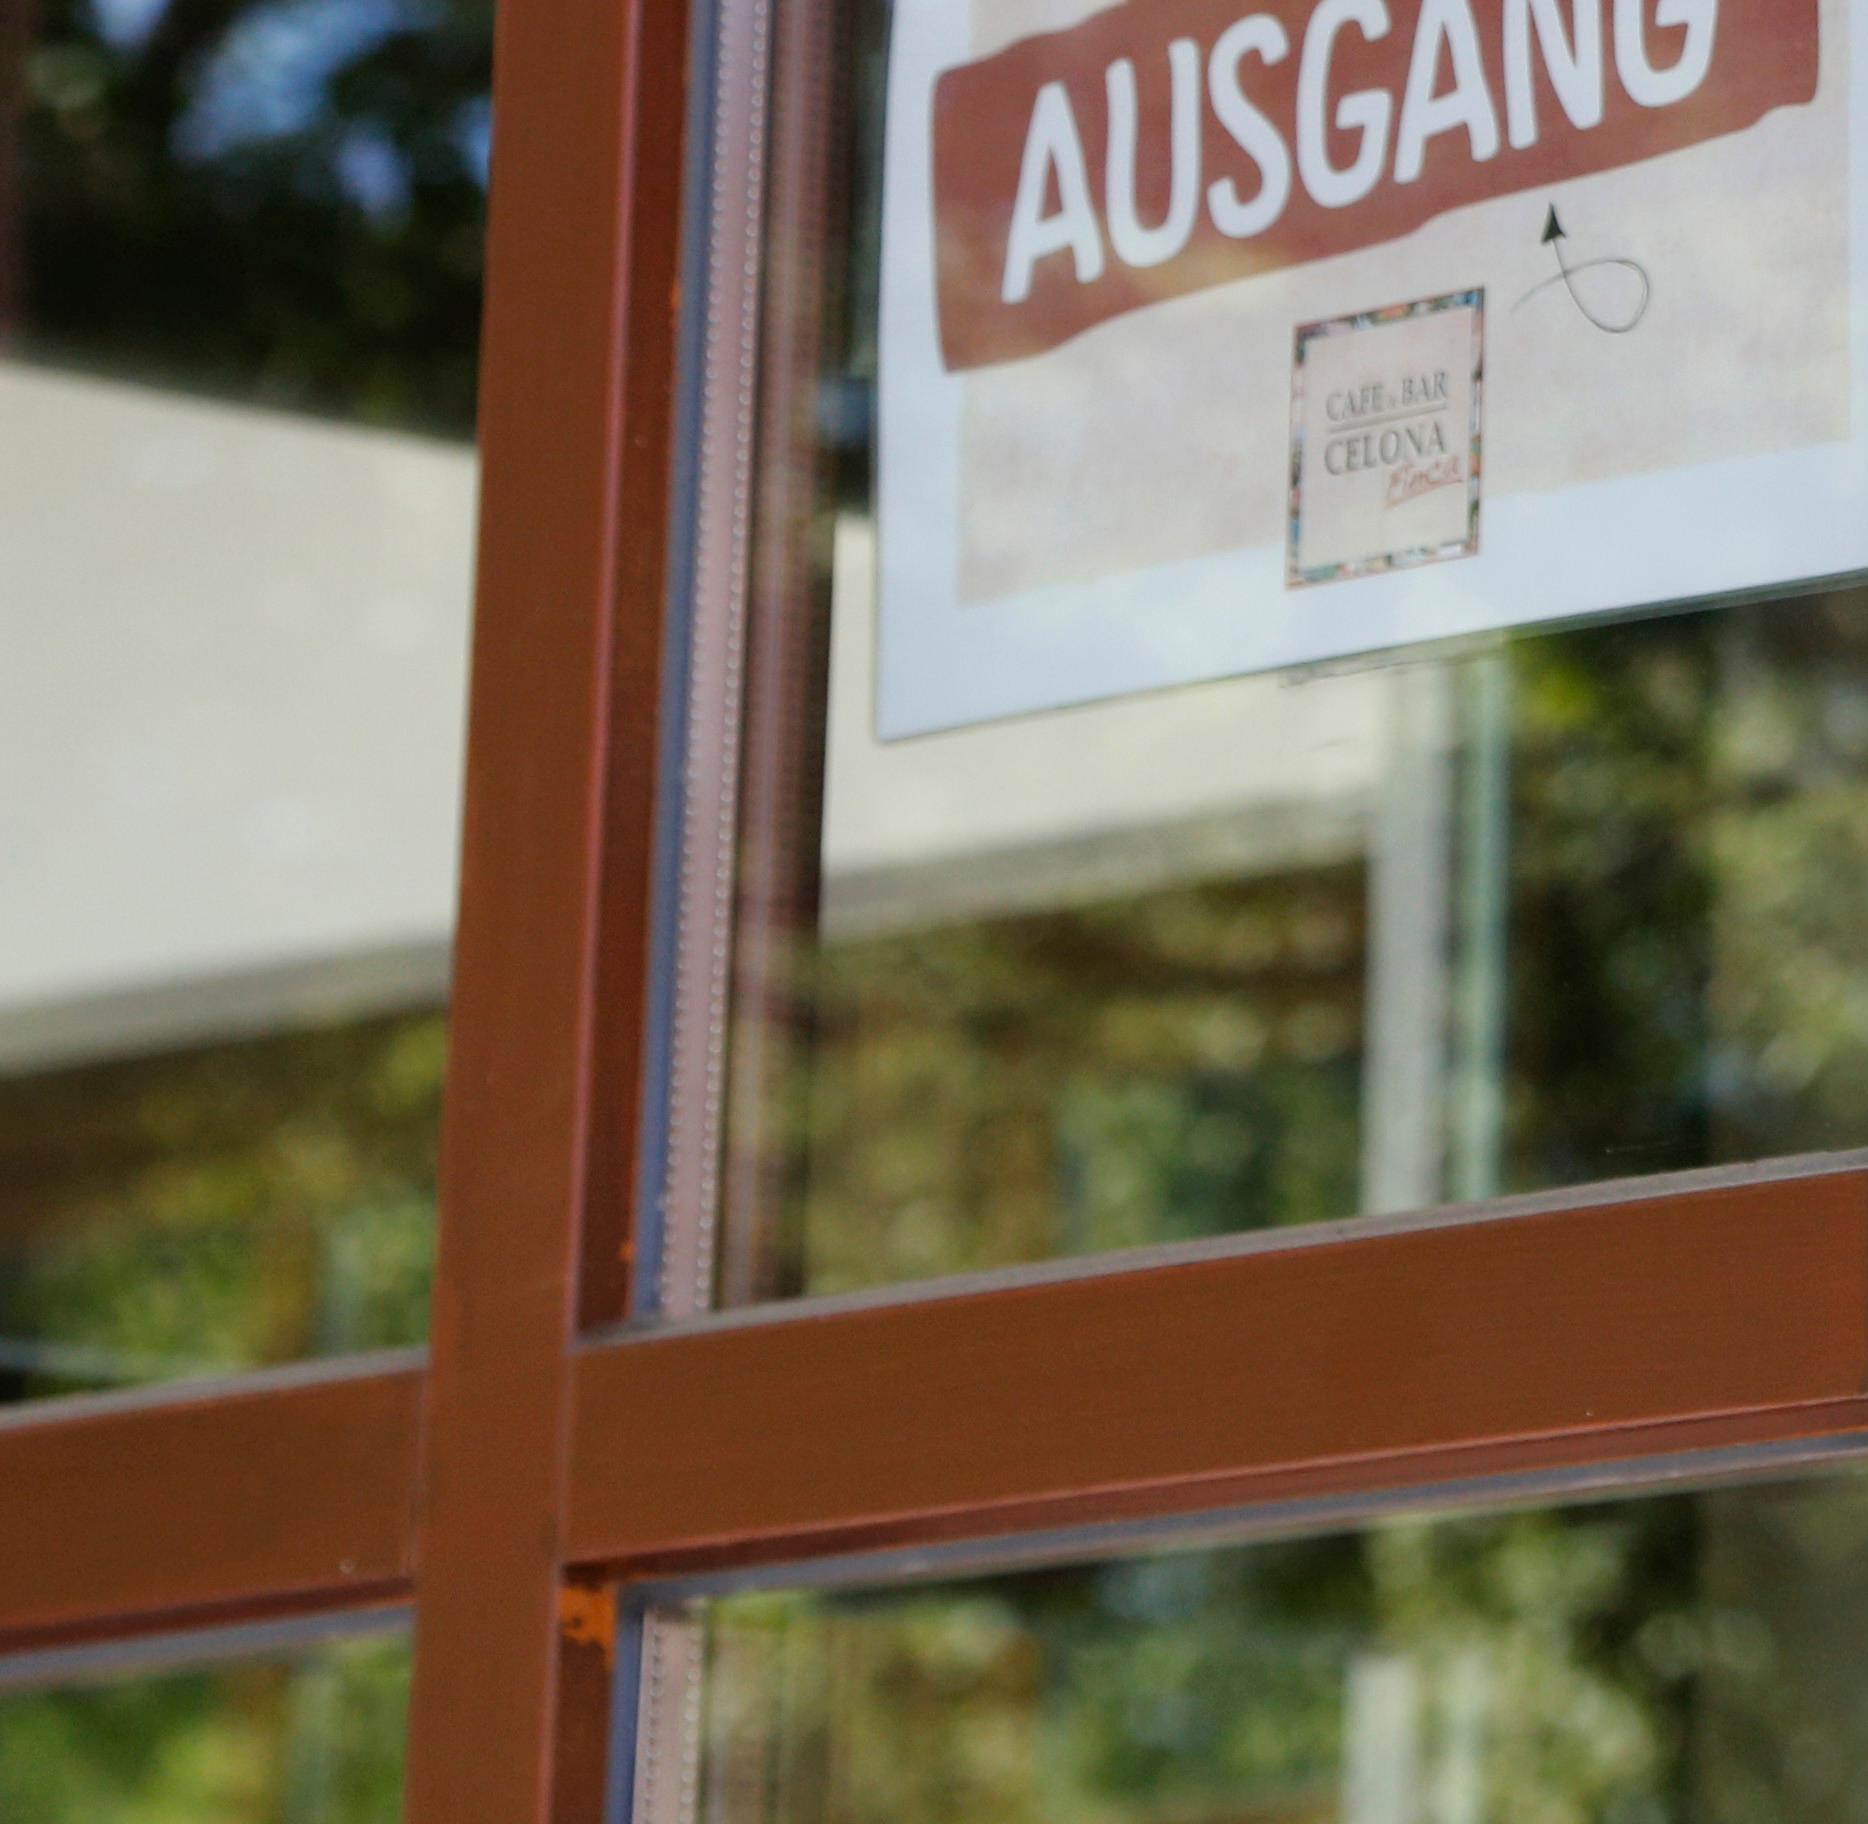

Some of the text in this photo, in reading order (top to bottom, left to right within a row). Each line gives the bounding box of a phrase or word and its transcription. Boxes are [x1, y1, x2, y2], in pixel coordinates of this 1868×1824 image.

[1325, 383, 1384, 421] CAFE
[1402, 370, 1448, 405] BAR
[1323, 419, 1448, 476] CELONA
